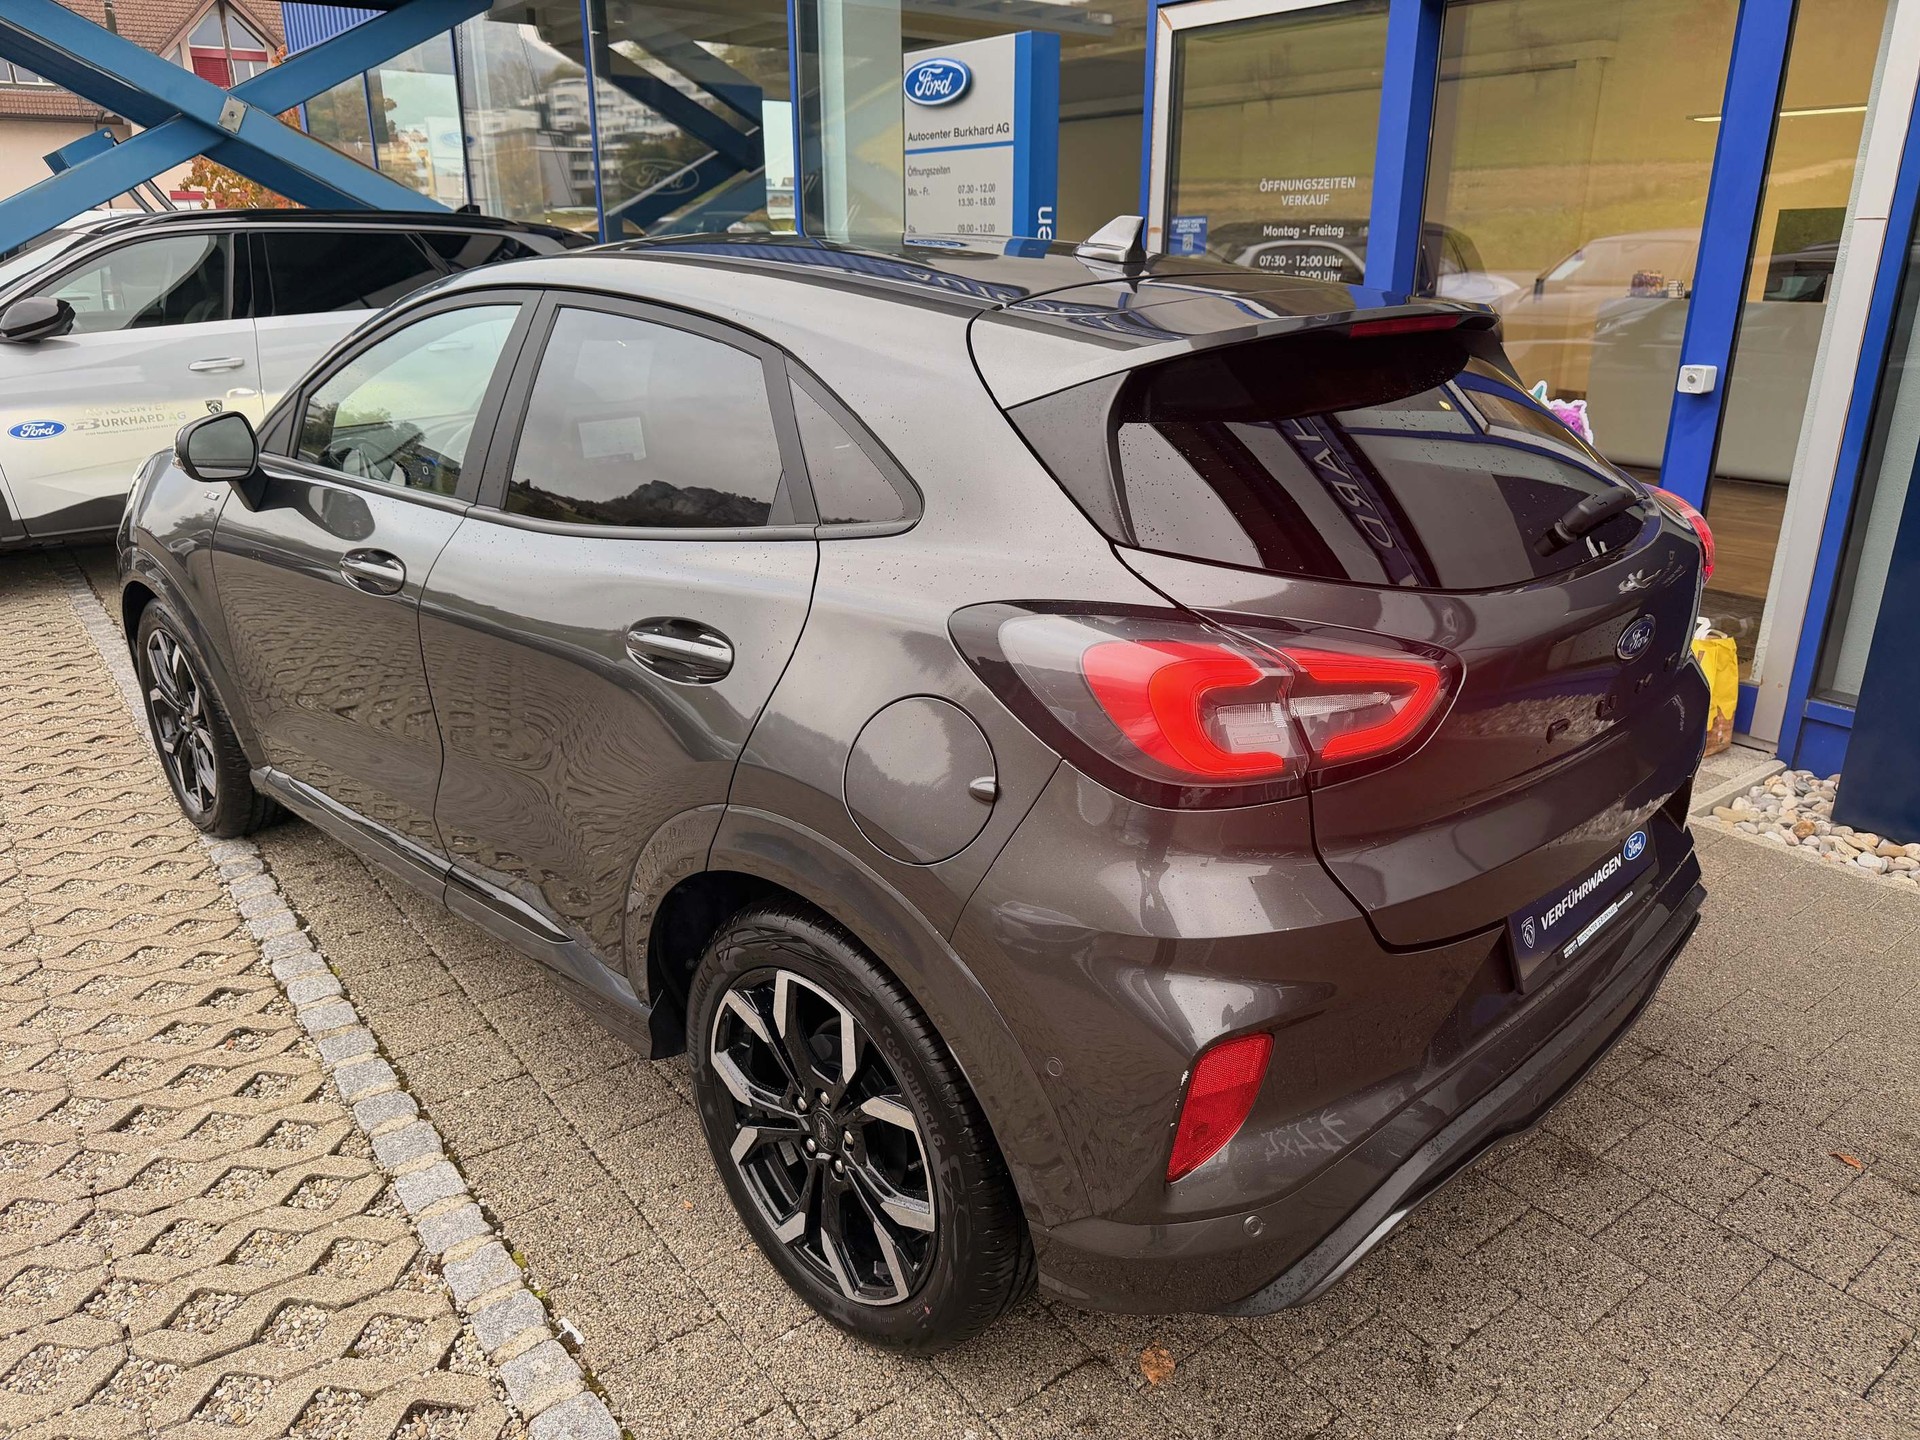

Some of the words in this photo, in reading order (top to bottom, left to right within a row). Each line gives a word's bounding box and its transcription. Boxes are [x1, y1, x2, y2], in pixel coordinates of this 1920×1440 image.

[914, 66, 953, 97] Ford
[907, 130, 951, 142] Autocenter
[953, 124, 994, 138] Burkhard
[996, 122, 1010, 134] AG
[907, 165, 951, 178] Öffnungszeiten
[957, 184, 974, 194] 07.30
[979, 183, 996, 193] 12.00
[1259, 176, 1356, 192] ÖFFNUNGSZEITEN
[957, 197, 974, 207] 13.30
[979, 197, 996, 206] 18.00
[1281, 193, 1330, 206] VERKAUF
[957, 223, 974, 233] 09.00
[979, 223, 996, 233] 12.00
[1262, 225, 1300, 239] Montag
[1309, 224, 1345, 239] Freitag
[1259, 255, 1287, 267] 07:30
[1295, 255, 1322, 267] 12:00
[1324, 254, 1343, 268] Uhr
[1323, 270, 1341, 282] Uhr
[72, 413, 165, 432] BURKHARD
[1540, 852, 1622, 931] VERFÜHRWAGEN
[932, 1132, 946, 1147] 6
